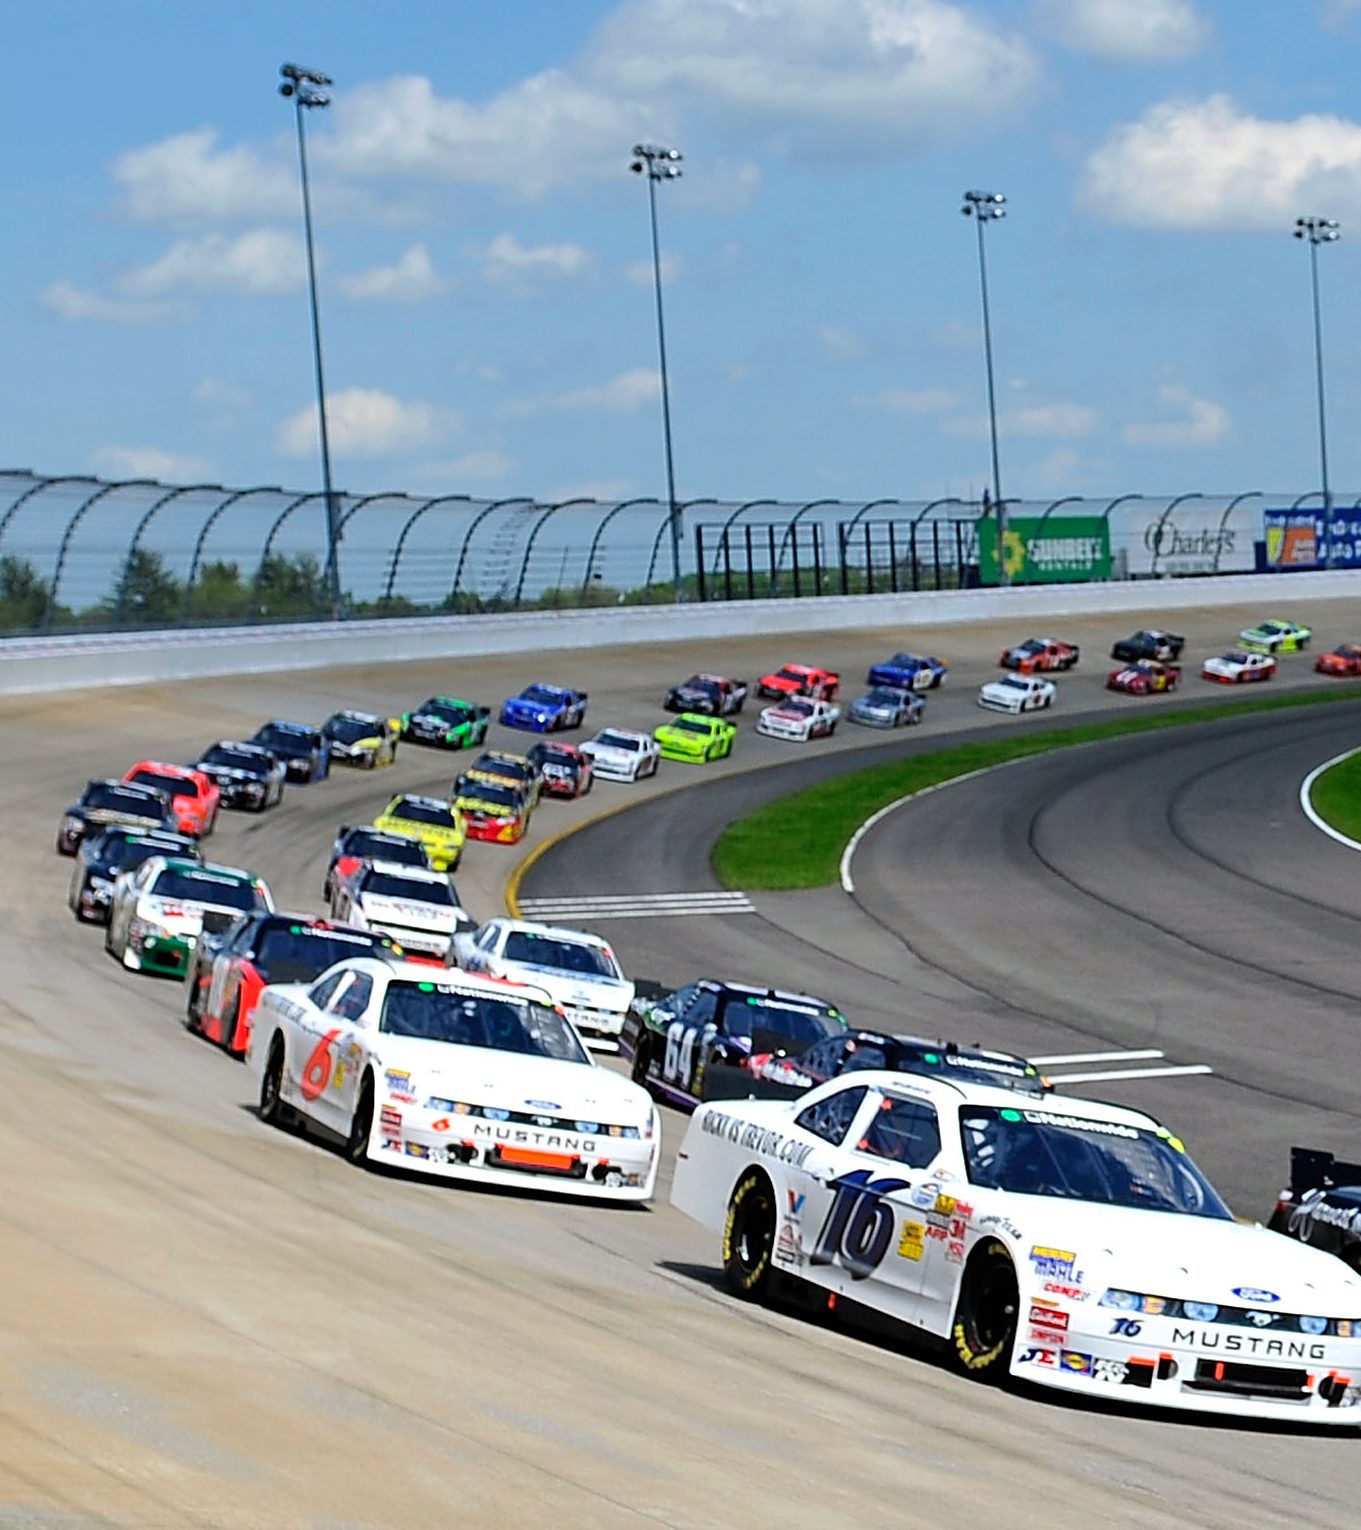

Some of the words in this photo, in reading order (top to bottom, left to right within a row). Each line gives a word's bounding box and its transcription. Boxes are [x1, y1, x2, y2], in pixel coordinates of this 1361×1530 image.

[1318, 540, 1353, 558] Auto
[302, 1029, 343, 1103] 6
[663, 1021, 698, 1091] 64
[474, 1123, 597, 1152] MUSTANG
[1040, 1111, 1140, 1140] Nationwide
[810, 1169, 911, 1281] 16
[1108, 1317, 1144, 1338] 16
[1172, 1327, 1327, 1360] MUSTANG
